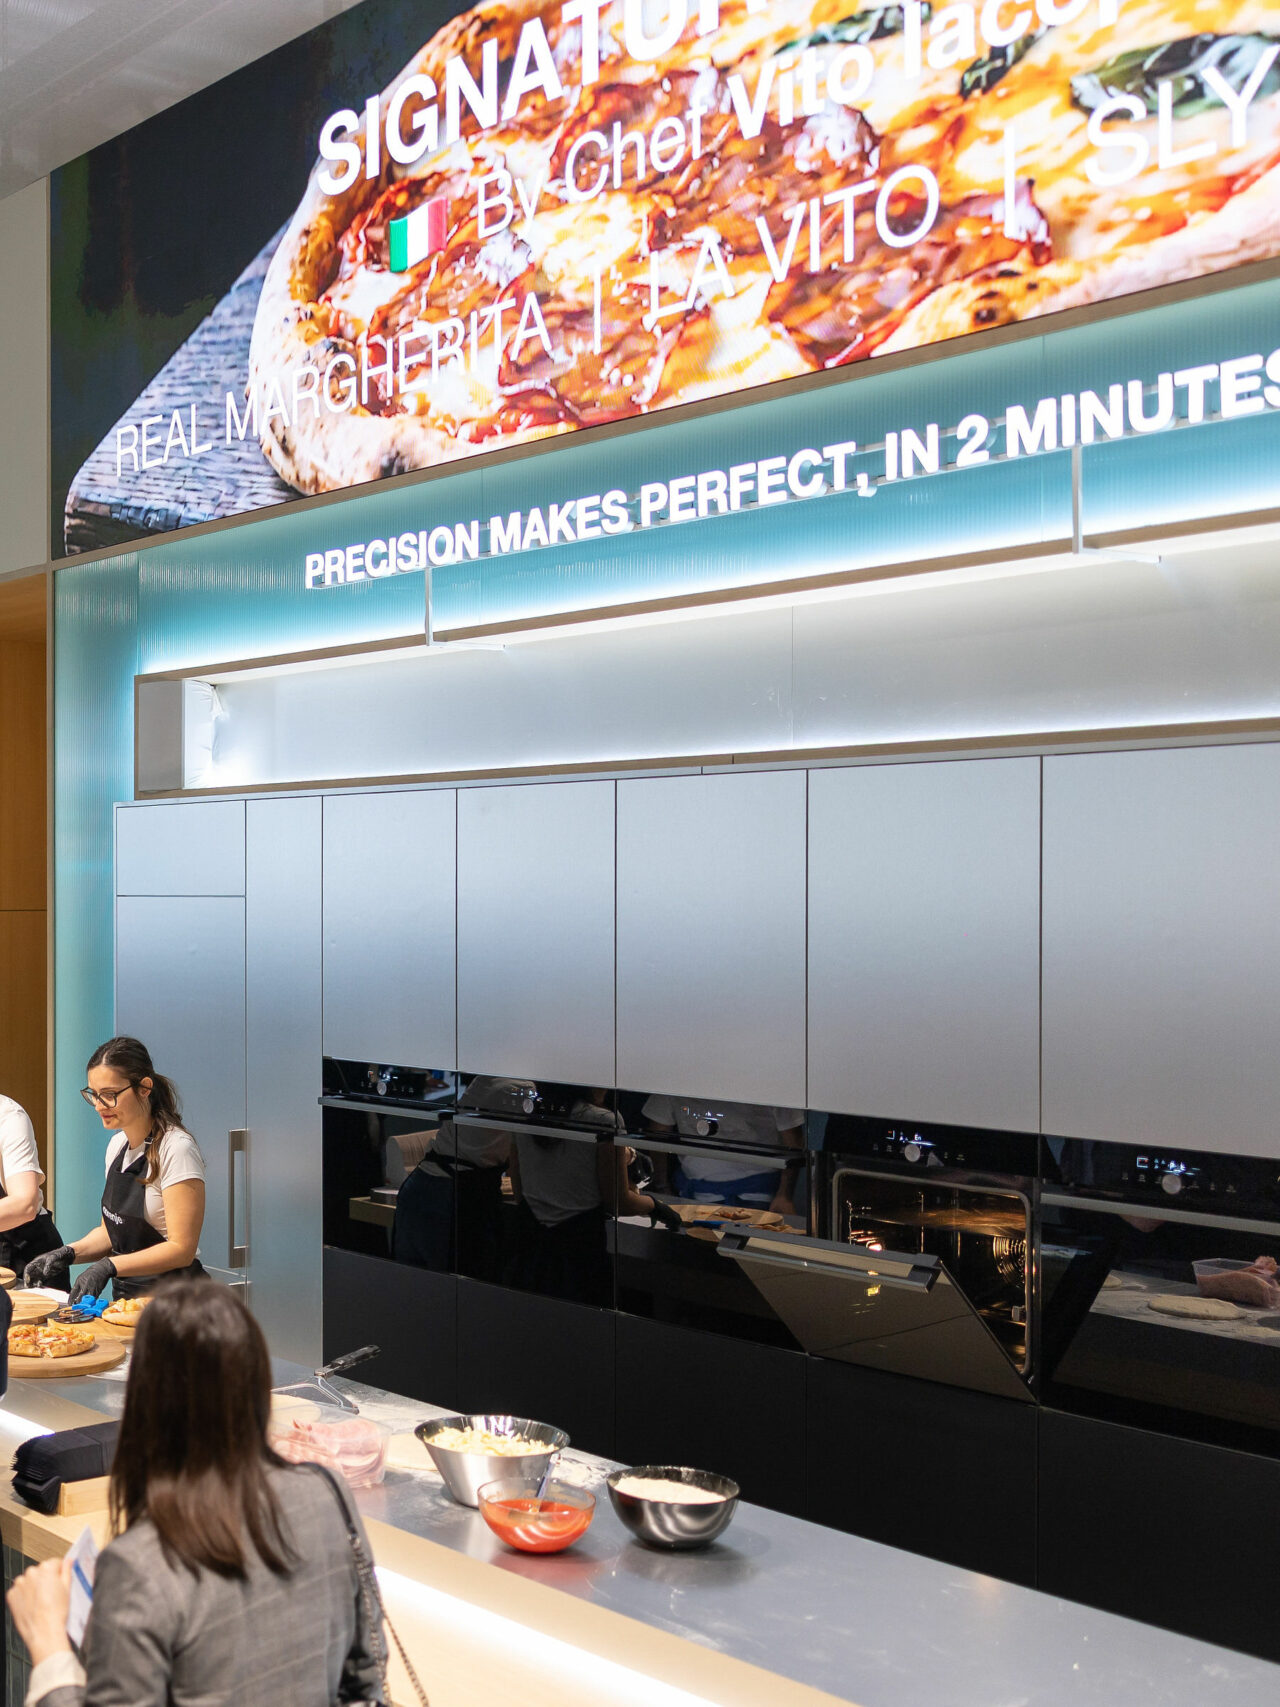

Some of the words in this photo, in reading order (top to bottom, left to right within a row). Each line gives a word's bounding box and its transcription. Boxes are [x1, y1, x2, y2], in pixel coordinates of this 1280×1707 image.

[477, 168, 543, 242] By
[565, 88, 711, 201] Chef
[726, 43, 875, 140] Vito
[904, 0, 1118, 80] Iac
[115, 403, 213, 478] REAL
[225, 292, 553, 446] MARGHERITA
[648, 233, 736, 318] LA
[754, 164, 940, 284] VITO
[1085, 43, 1280, 188] SLY
[304, 519, 480, 589] PRECISION
[489, 489, 629, 556] MAKES
[639, 440, 870, 528] PERFECT,
[885, 423, 940, 481] IN
[955, 413, 990, 467] 2
